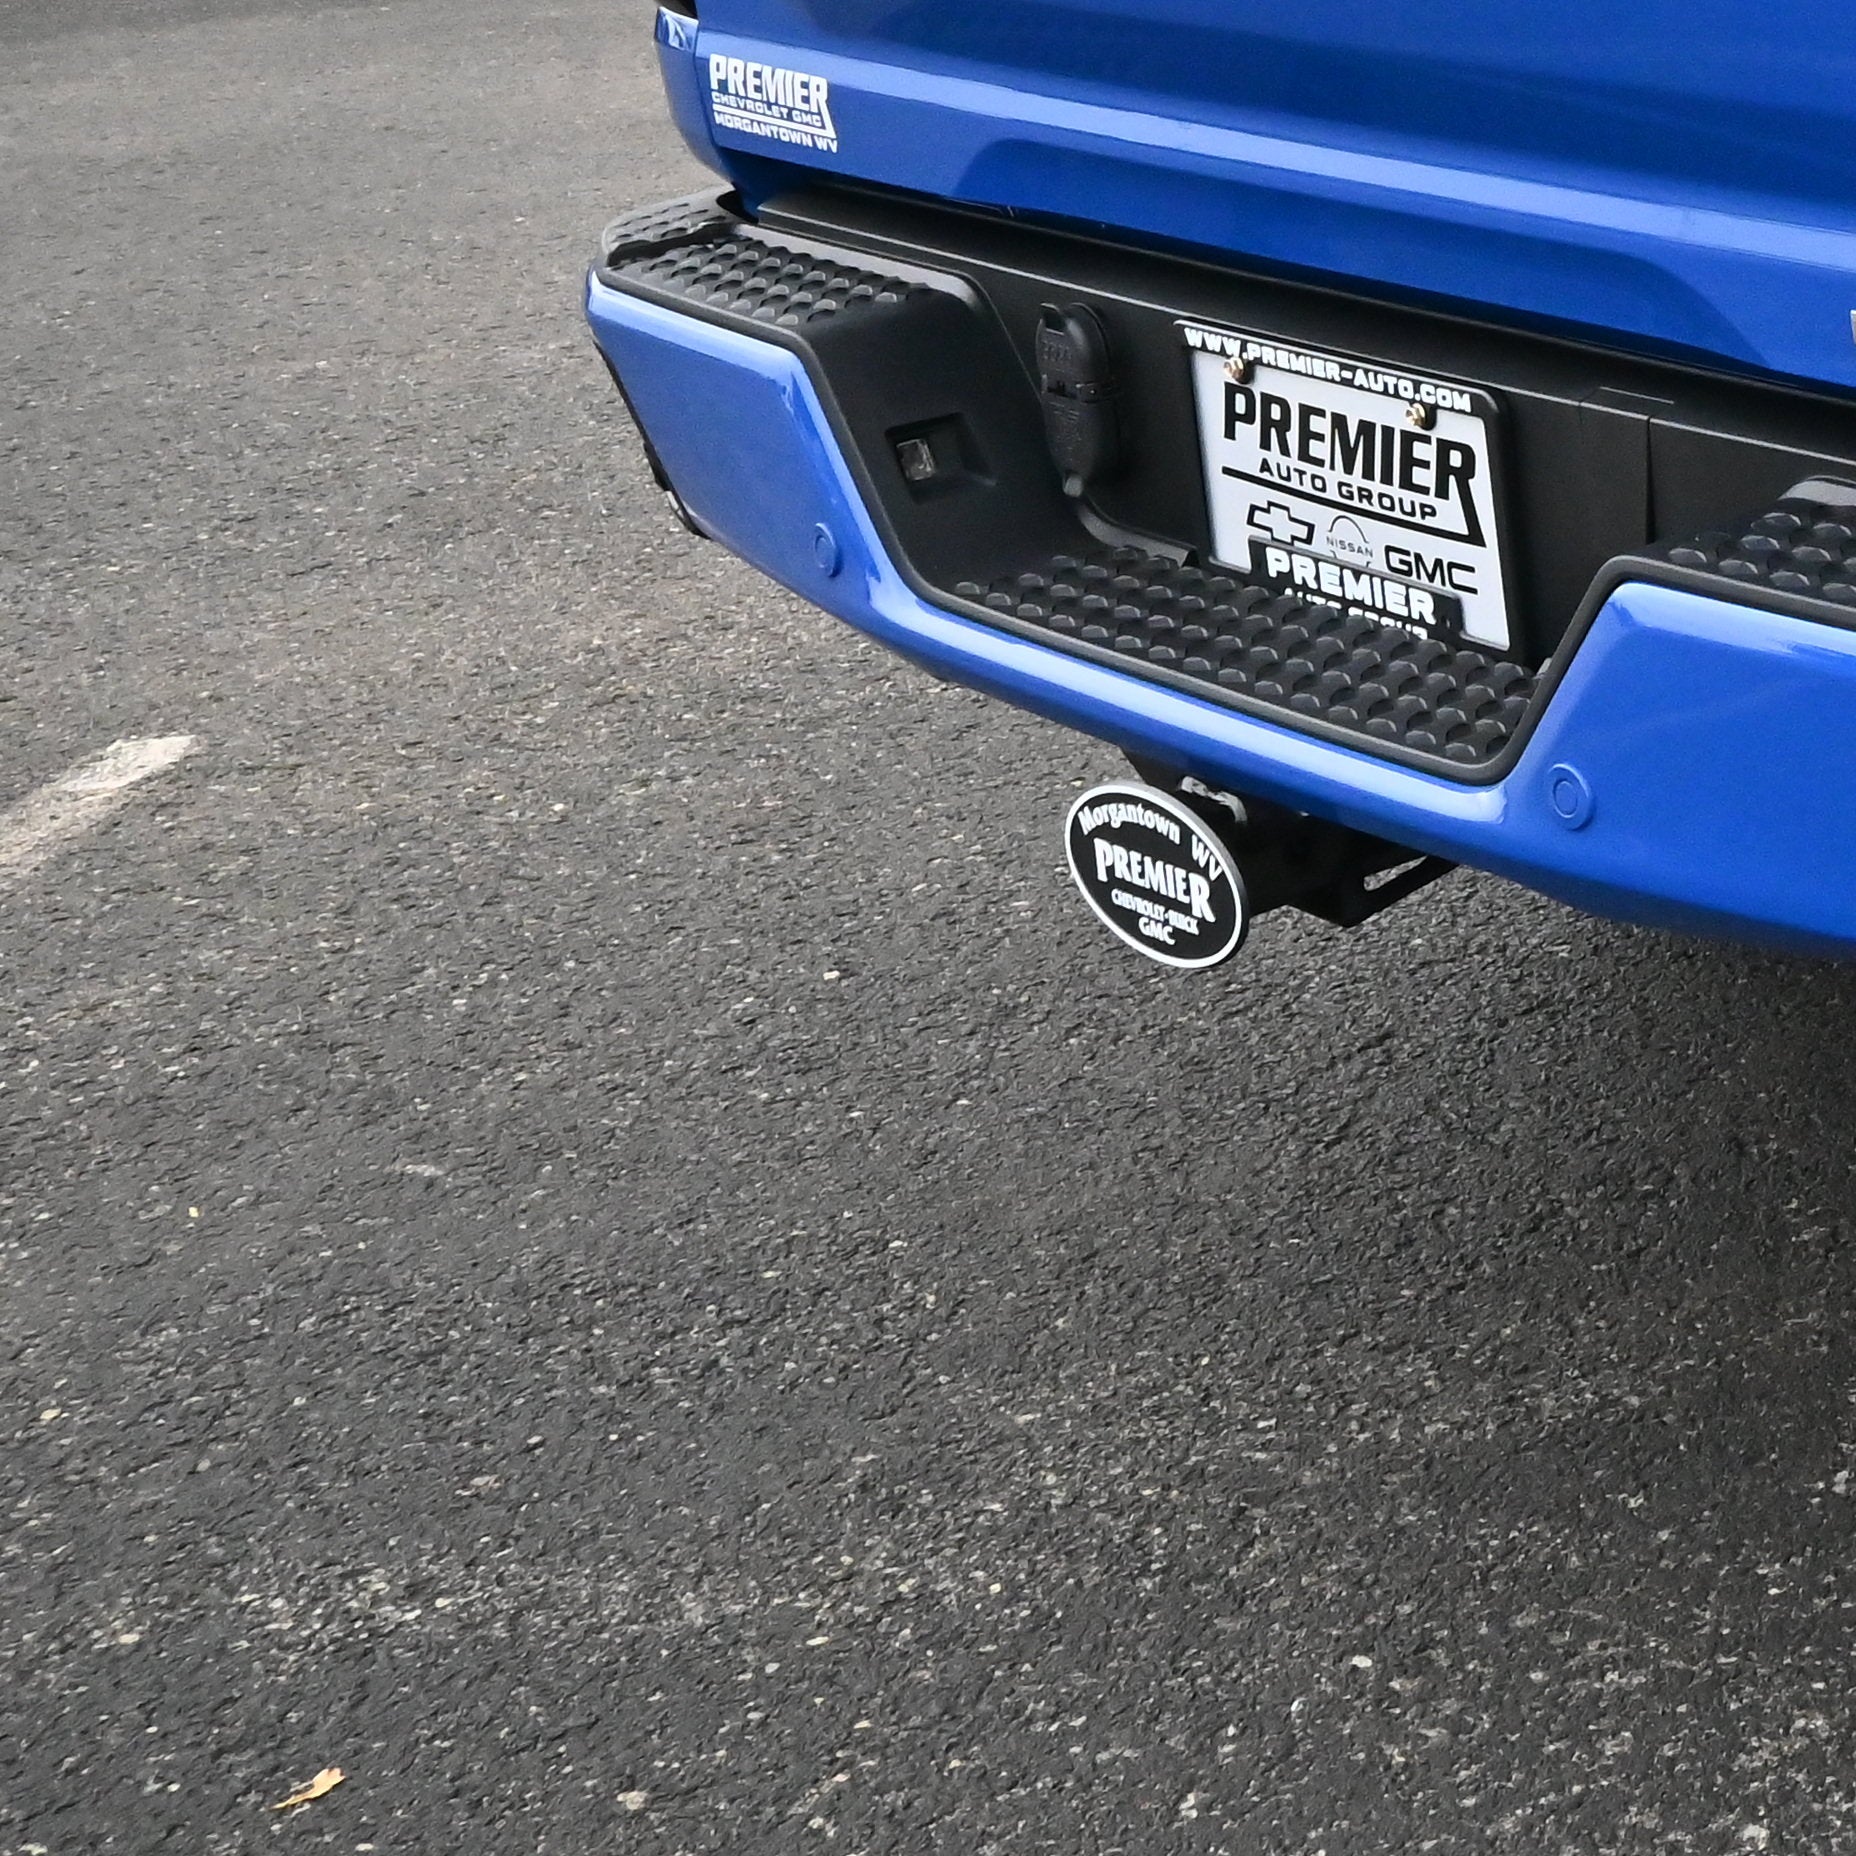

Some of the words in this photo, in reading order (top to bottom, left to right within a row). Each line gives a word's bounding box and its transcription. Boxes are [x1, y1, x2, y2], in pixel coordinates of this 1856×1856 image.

[709, 53, 829, 114] PREMIER
[713, 92, 789, 120] CHEVROLET
[792, 109, 824, 128] GMC
[715, 114, 813, 147] MORGANTOWN
[815, 136, 838, 154] WV
[1184, 327, 1471, 412] WWW.PREMIER-AUTO.COM
[1223, 381, 1476, 501] PREMIER
[1258, 457, 1328, 494] AUTO
[1337, 480, 1437, 520] GROUP
[1326, 535, 1374, 557] NISSAN
[1384, 545, 1479, 595] GMC
[1265, 546, 1437, 625] PREMIER
[1077, 802, 1181, 845] Morgantown
[1191, 834, 1223, 882] WV
[1093, 837, 1216, 923] PREMIER
[1138, 916, 1176, 946] GMC
